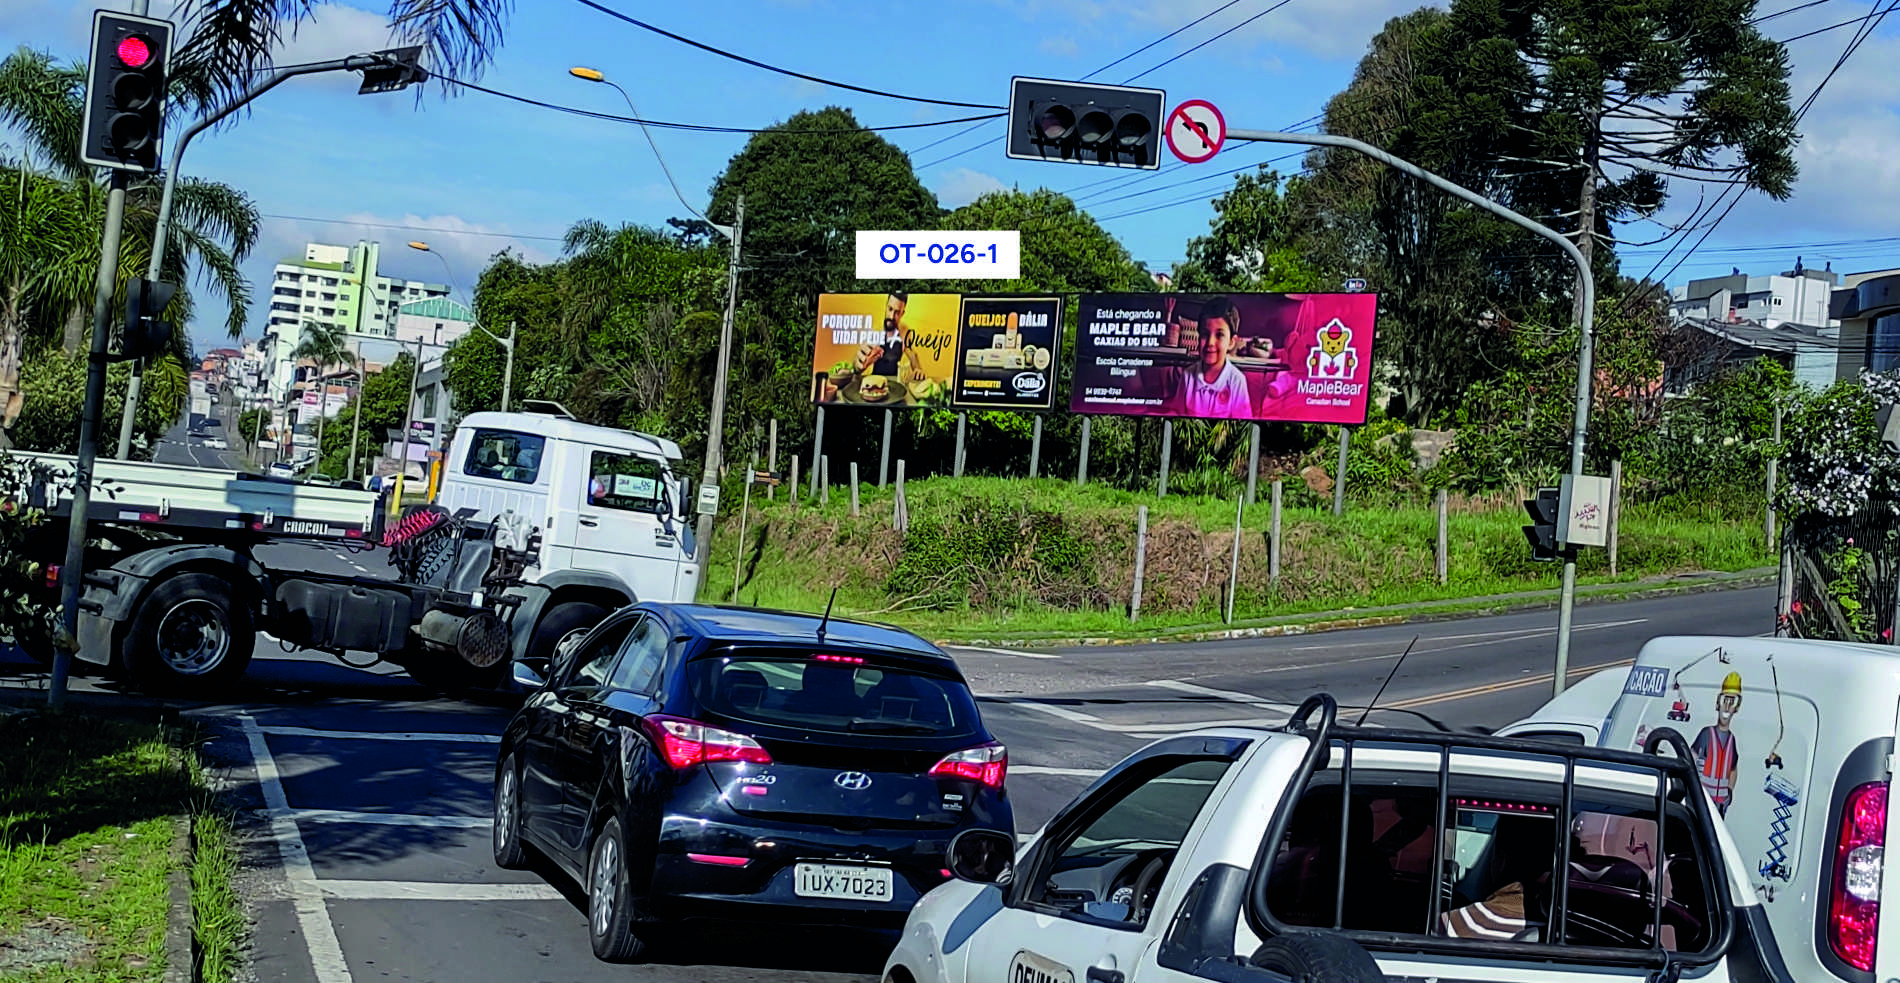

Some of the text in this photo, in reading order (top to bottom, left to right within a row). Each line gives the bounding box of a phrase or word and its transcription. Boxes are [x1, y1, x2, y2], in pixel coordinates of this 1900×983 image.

[822, 314, 873, 329] PORQUE A
[969, 311, 1048, 328] QUEIJOS DÁLIA
[1096, 308, 1162, 321] Está chegando a
[1089, 322, 1166, 336] MAPLE BEAR
[832, 329, 858, 345] VIDA
[859, 330, 886, 346] PEDE
[1094, 336, 1160, 346] CAXIAS DO SUL
[904, 329, 952, 362] Queijo
[1096, 357, 1117, 366] Escola
[1297, 379, 1364, 398] MapleBear
[283, 520, 329, 535] CROCOLI
